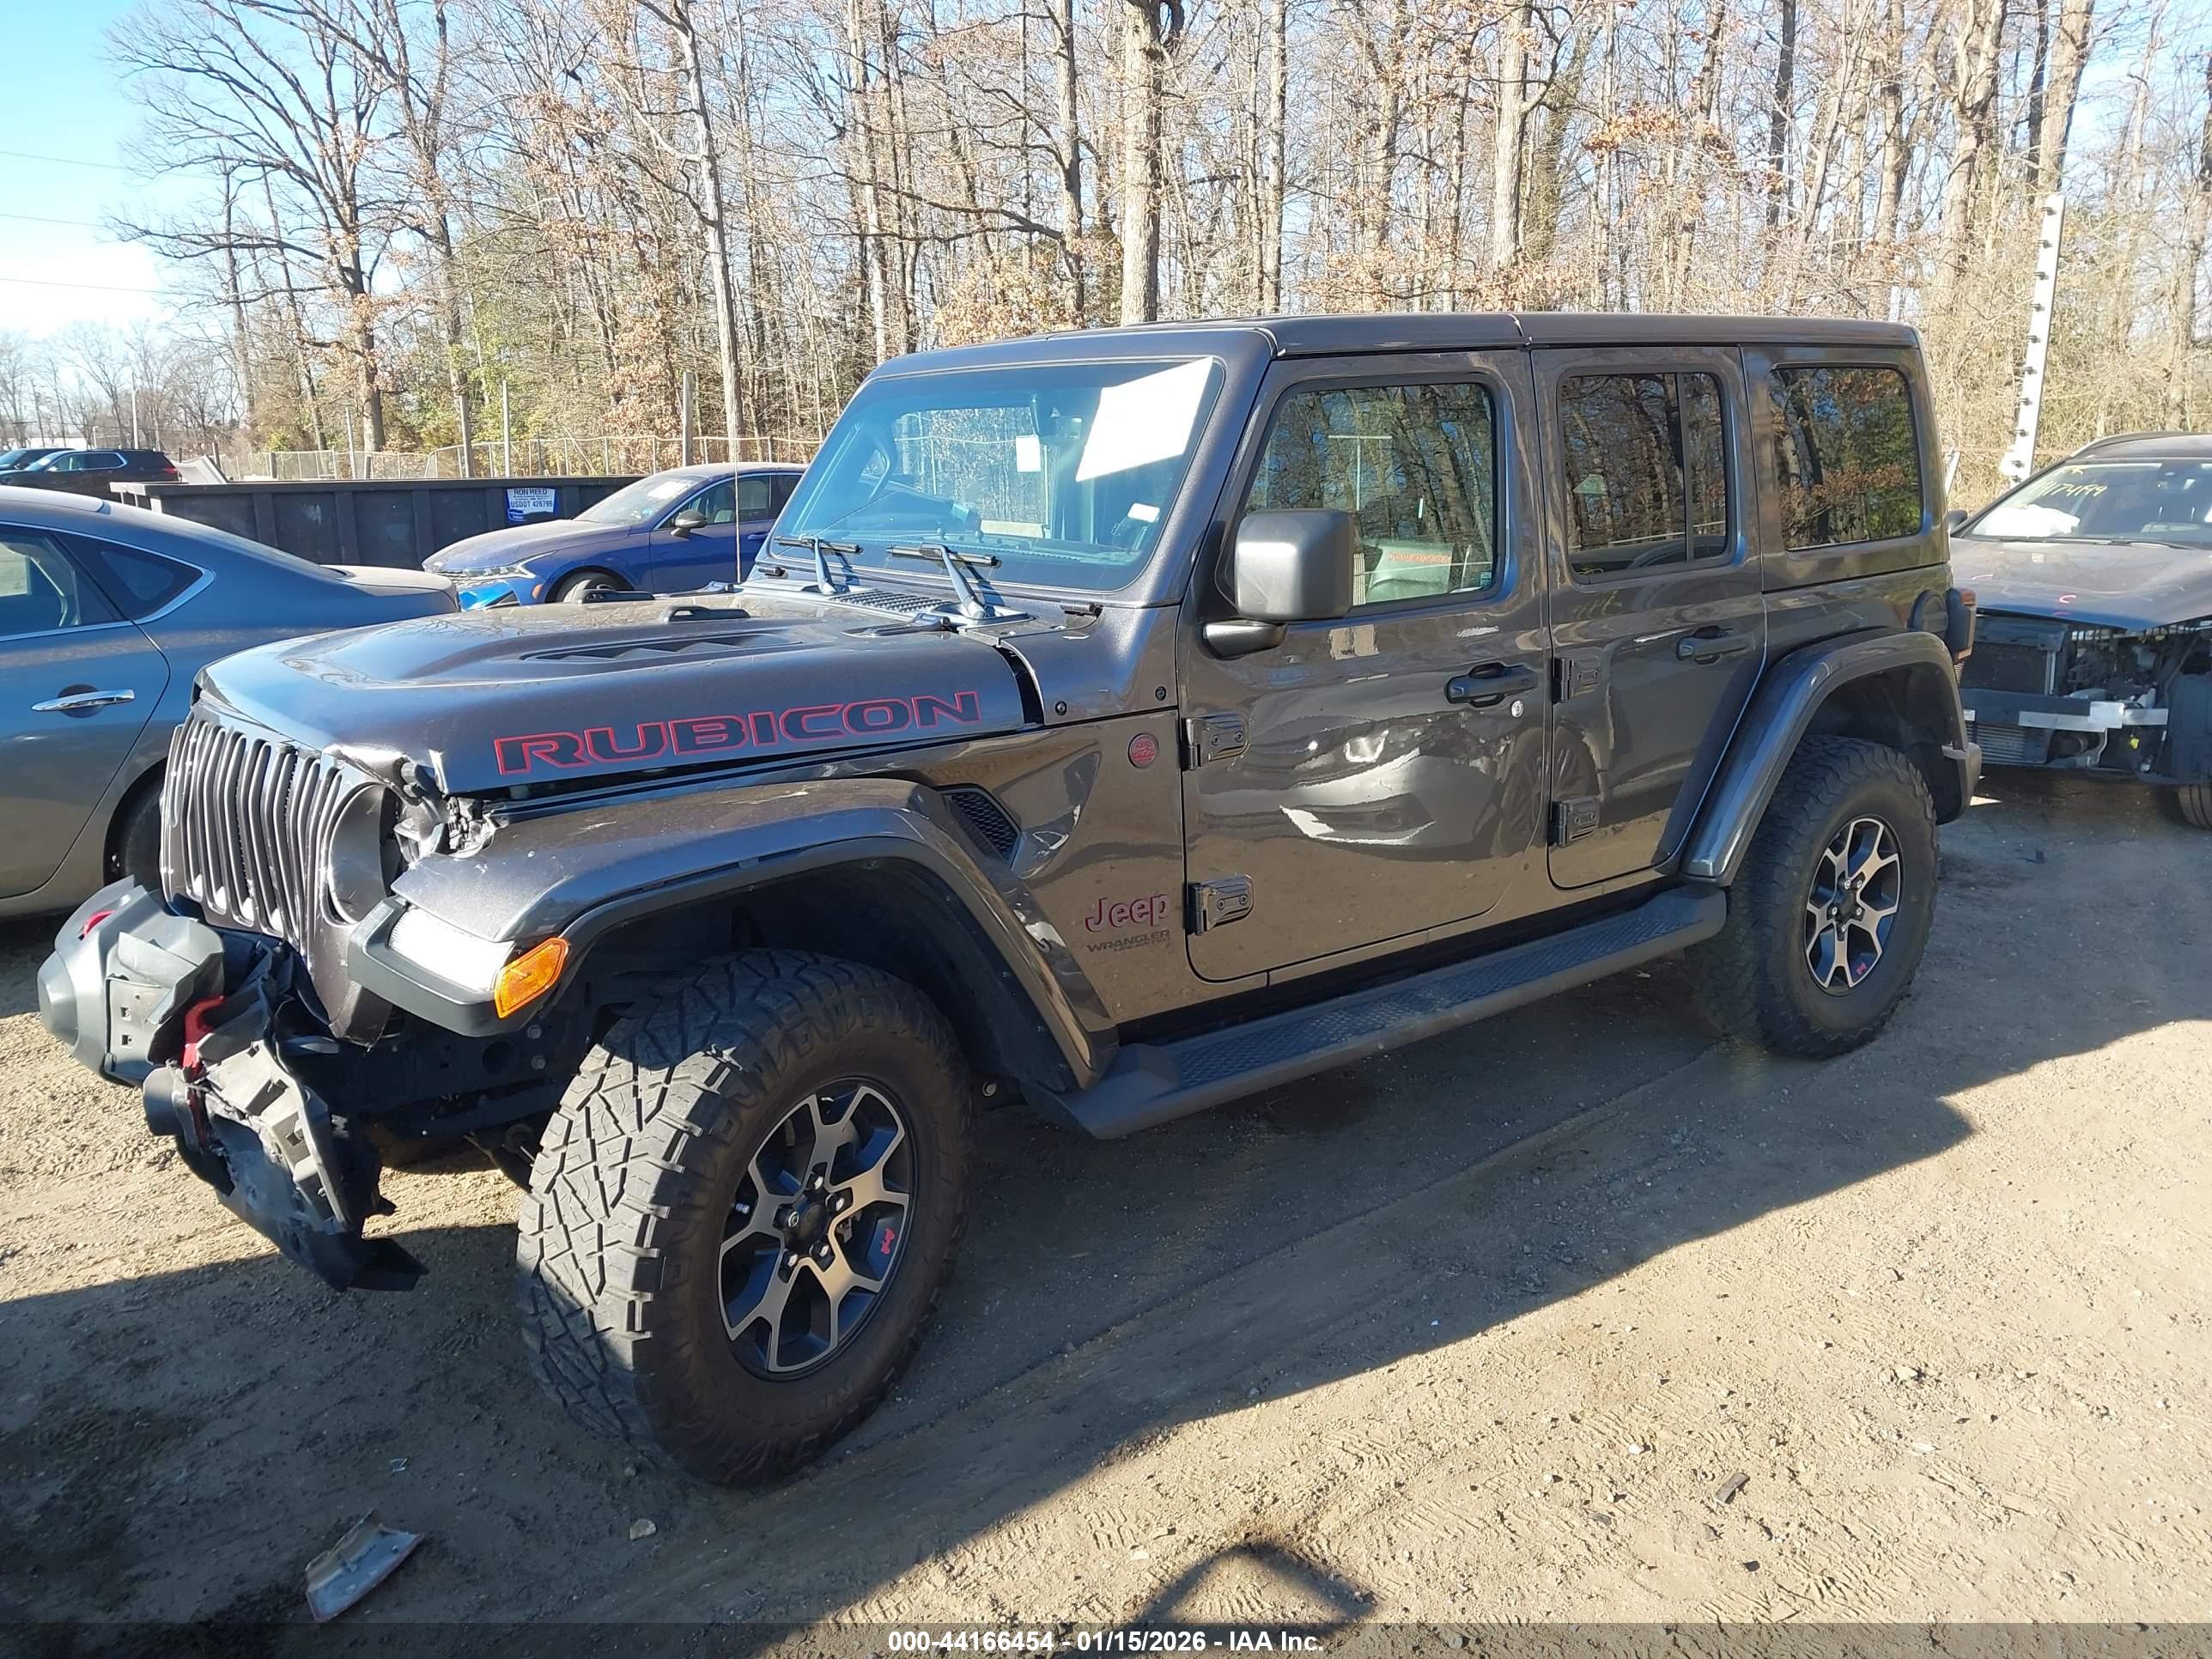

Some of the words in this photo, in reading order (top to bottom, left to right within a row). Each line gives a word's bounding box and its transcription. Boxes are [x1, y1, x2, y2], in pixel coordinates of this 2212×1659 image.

[2027, 480, 2108, 497] 174199
[510, 500, 531, 508] USDOT
[494, 690, 983, 776] RUBICON
[1085, 894, 1169, 933] Jeep
[1086, 929, 1170, 953] WRANGLER
